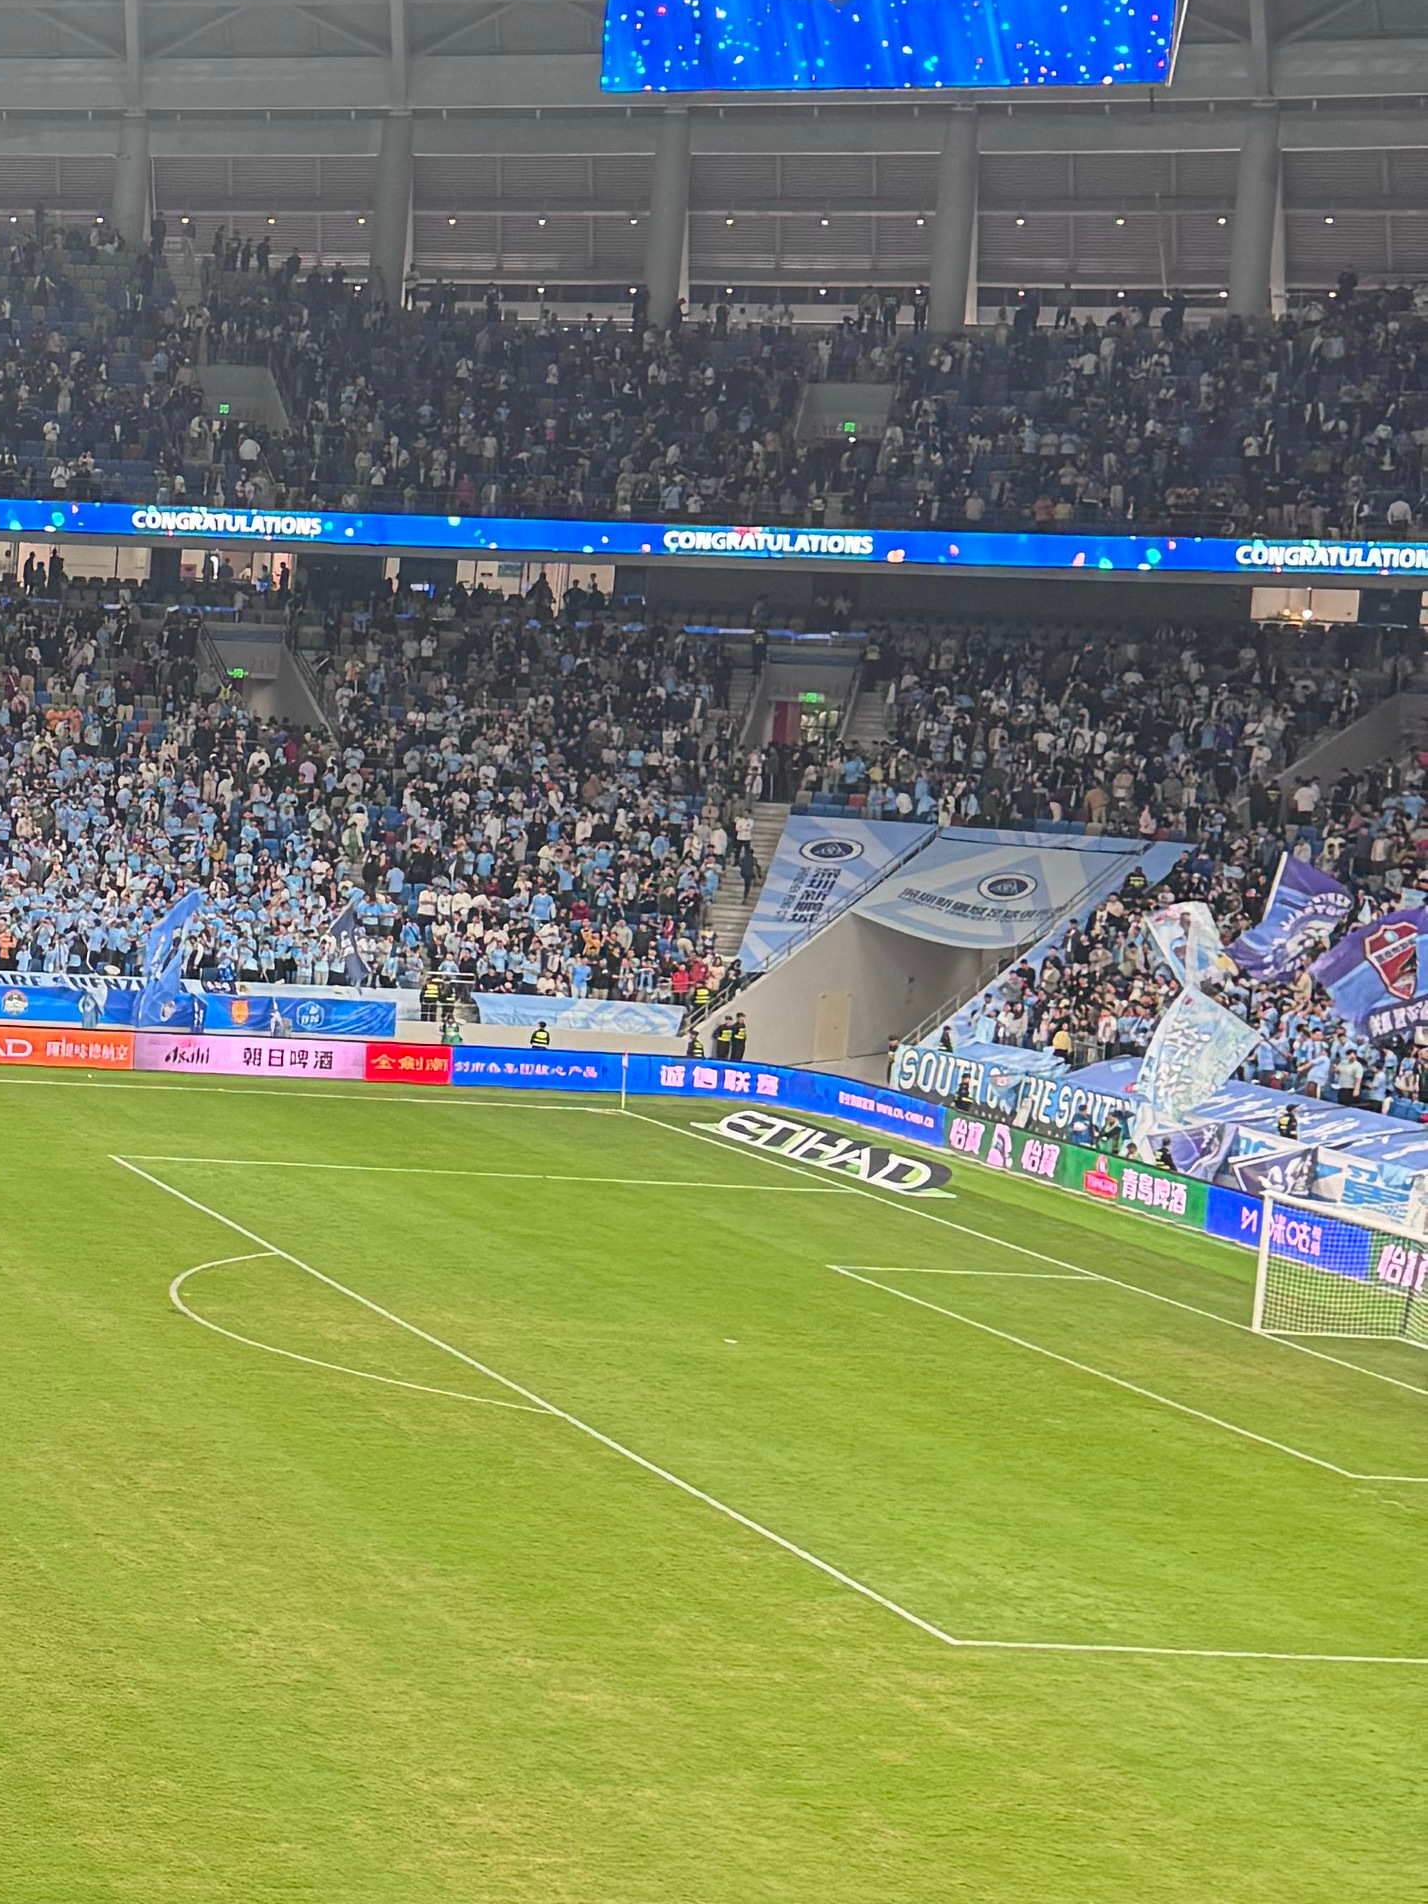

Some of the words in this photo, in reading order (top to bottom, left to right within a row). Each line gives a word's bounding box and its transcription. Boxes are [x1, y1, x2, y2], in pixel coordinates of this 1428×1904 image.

[132, 510, 323, 537] CONGRATULATIONS
[664, 531, 874, 556] CONGRATULATIONS
[164, 1041, 211, 1065] Asahi
[242, 1046, 334, 1070] 朝日啤酒
[659, 1063, 779, 1097] 诚信联赛
[716, 1109, 932, 1191] ETIHAD
[1122, 1167, 1188, 1216] 青岛啤酒
